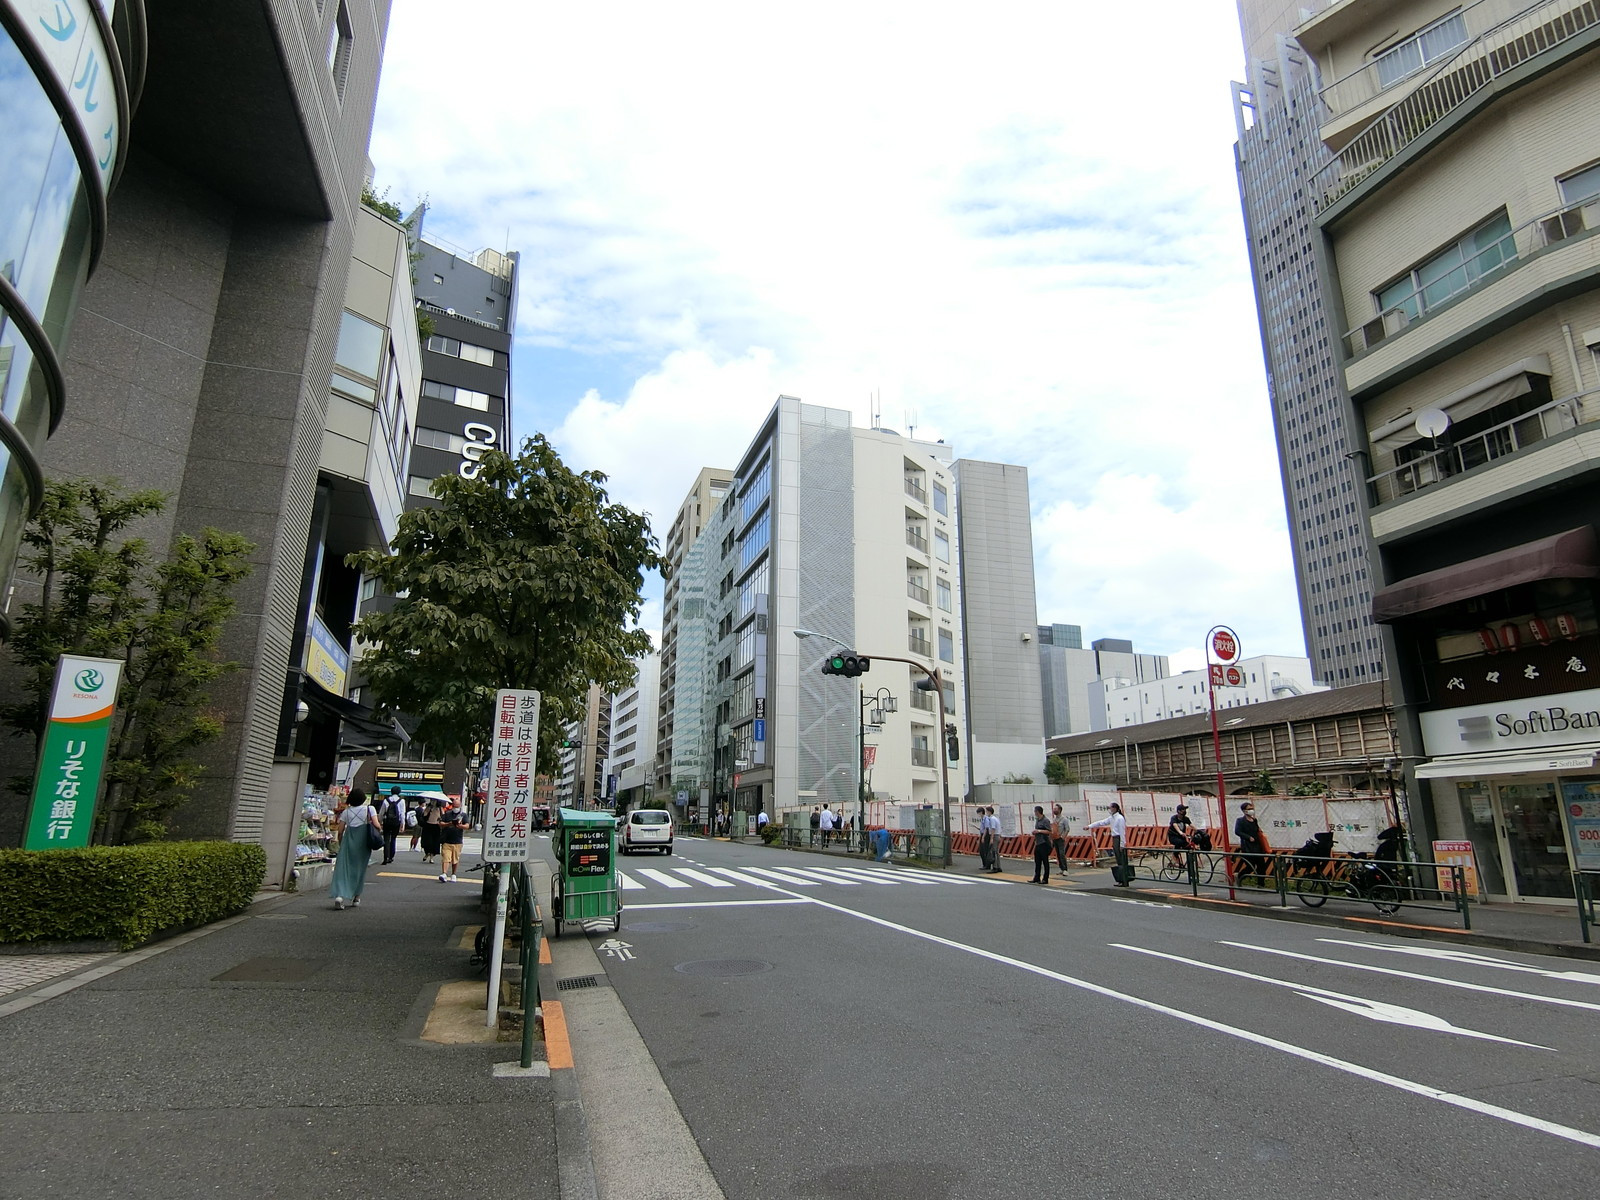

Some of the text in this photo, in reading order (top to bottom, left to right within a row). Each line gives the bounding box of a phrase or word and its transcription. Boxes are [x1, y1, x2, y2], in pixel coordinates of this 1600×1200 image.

[1214, 639, 1234, 653] 消火栓
[1446, 656, 1587, 690] 代々木庵
[491, 694, 517, 838] 自転車は車道寄りを
[510, 696, 536, 838] 歩道は歩行者が優先
[1559, 760, 1589, 768] SoftBank
[47, 740, 87, 840] りそな銀行
[590, 865, 605, 873] Flex
